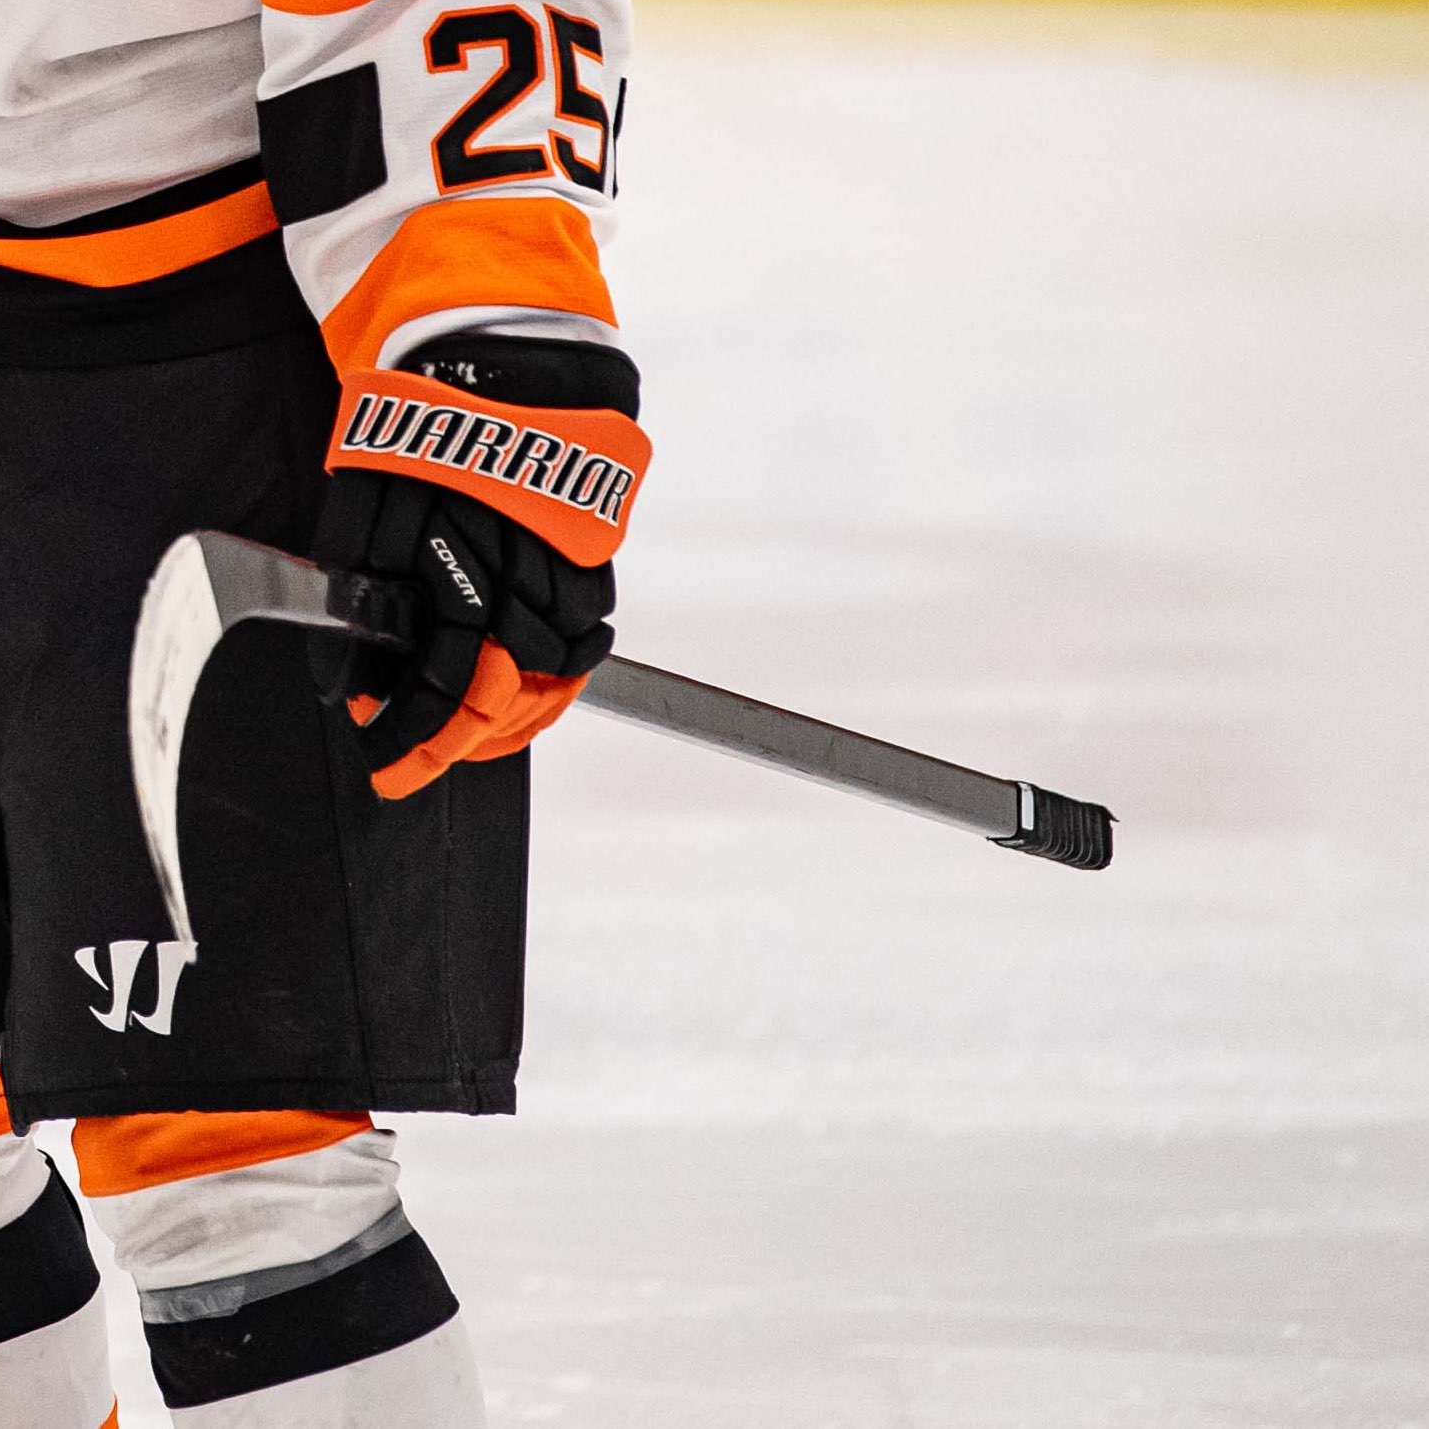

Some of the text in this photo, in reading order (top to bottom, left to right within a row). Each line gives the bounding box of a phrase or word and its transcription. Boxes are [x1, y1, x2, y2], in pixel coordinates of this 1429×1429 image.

[422, 3, 610, 198] 25
[340, 393, 636, 528] WARRIOR
[428, 536, 484, 608] COVERT
